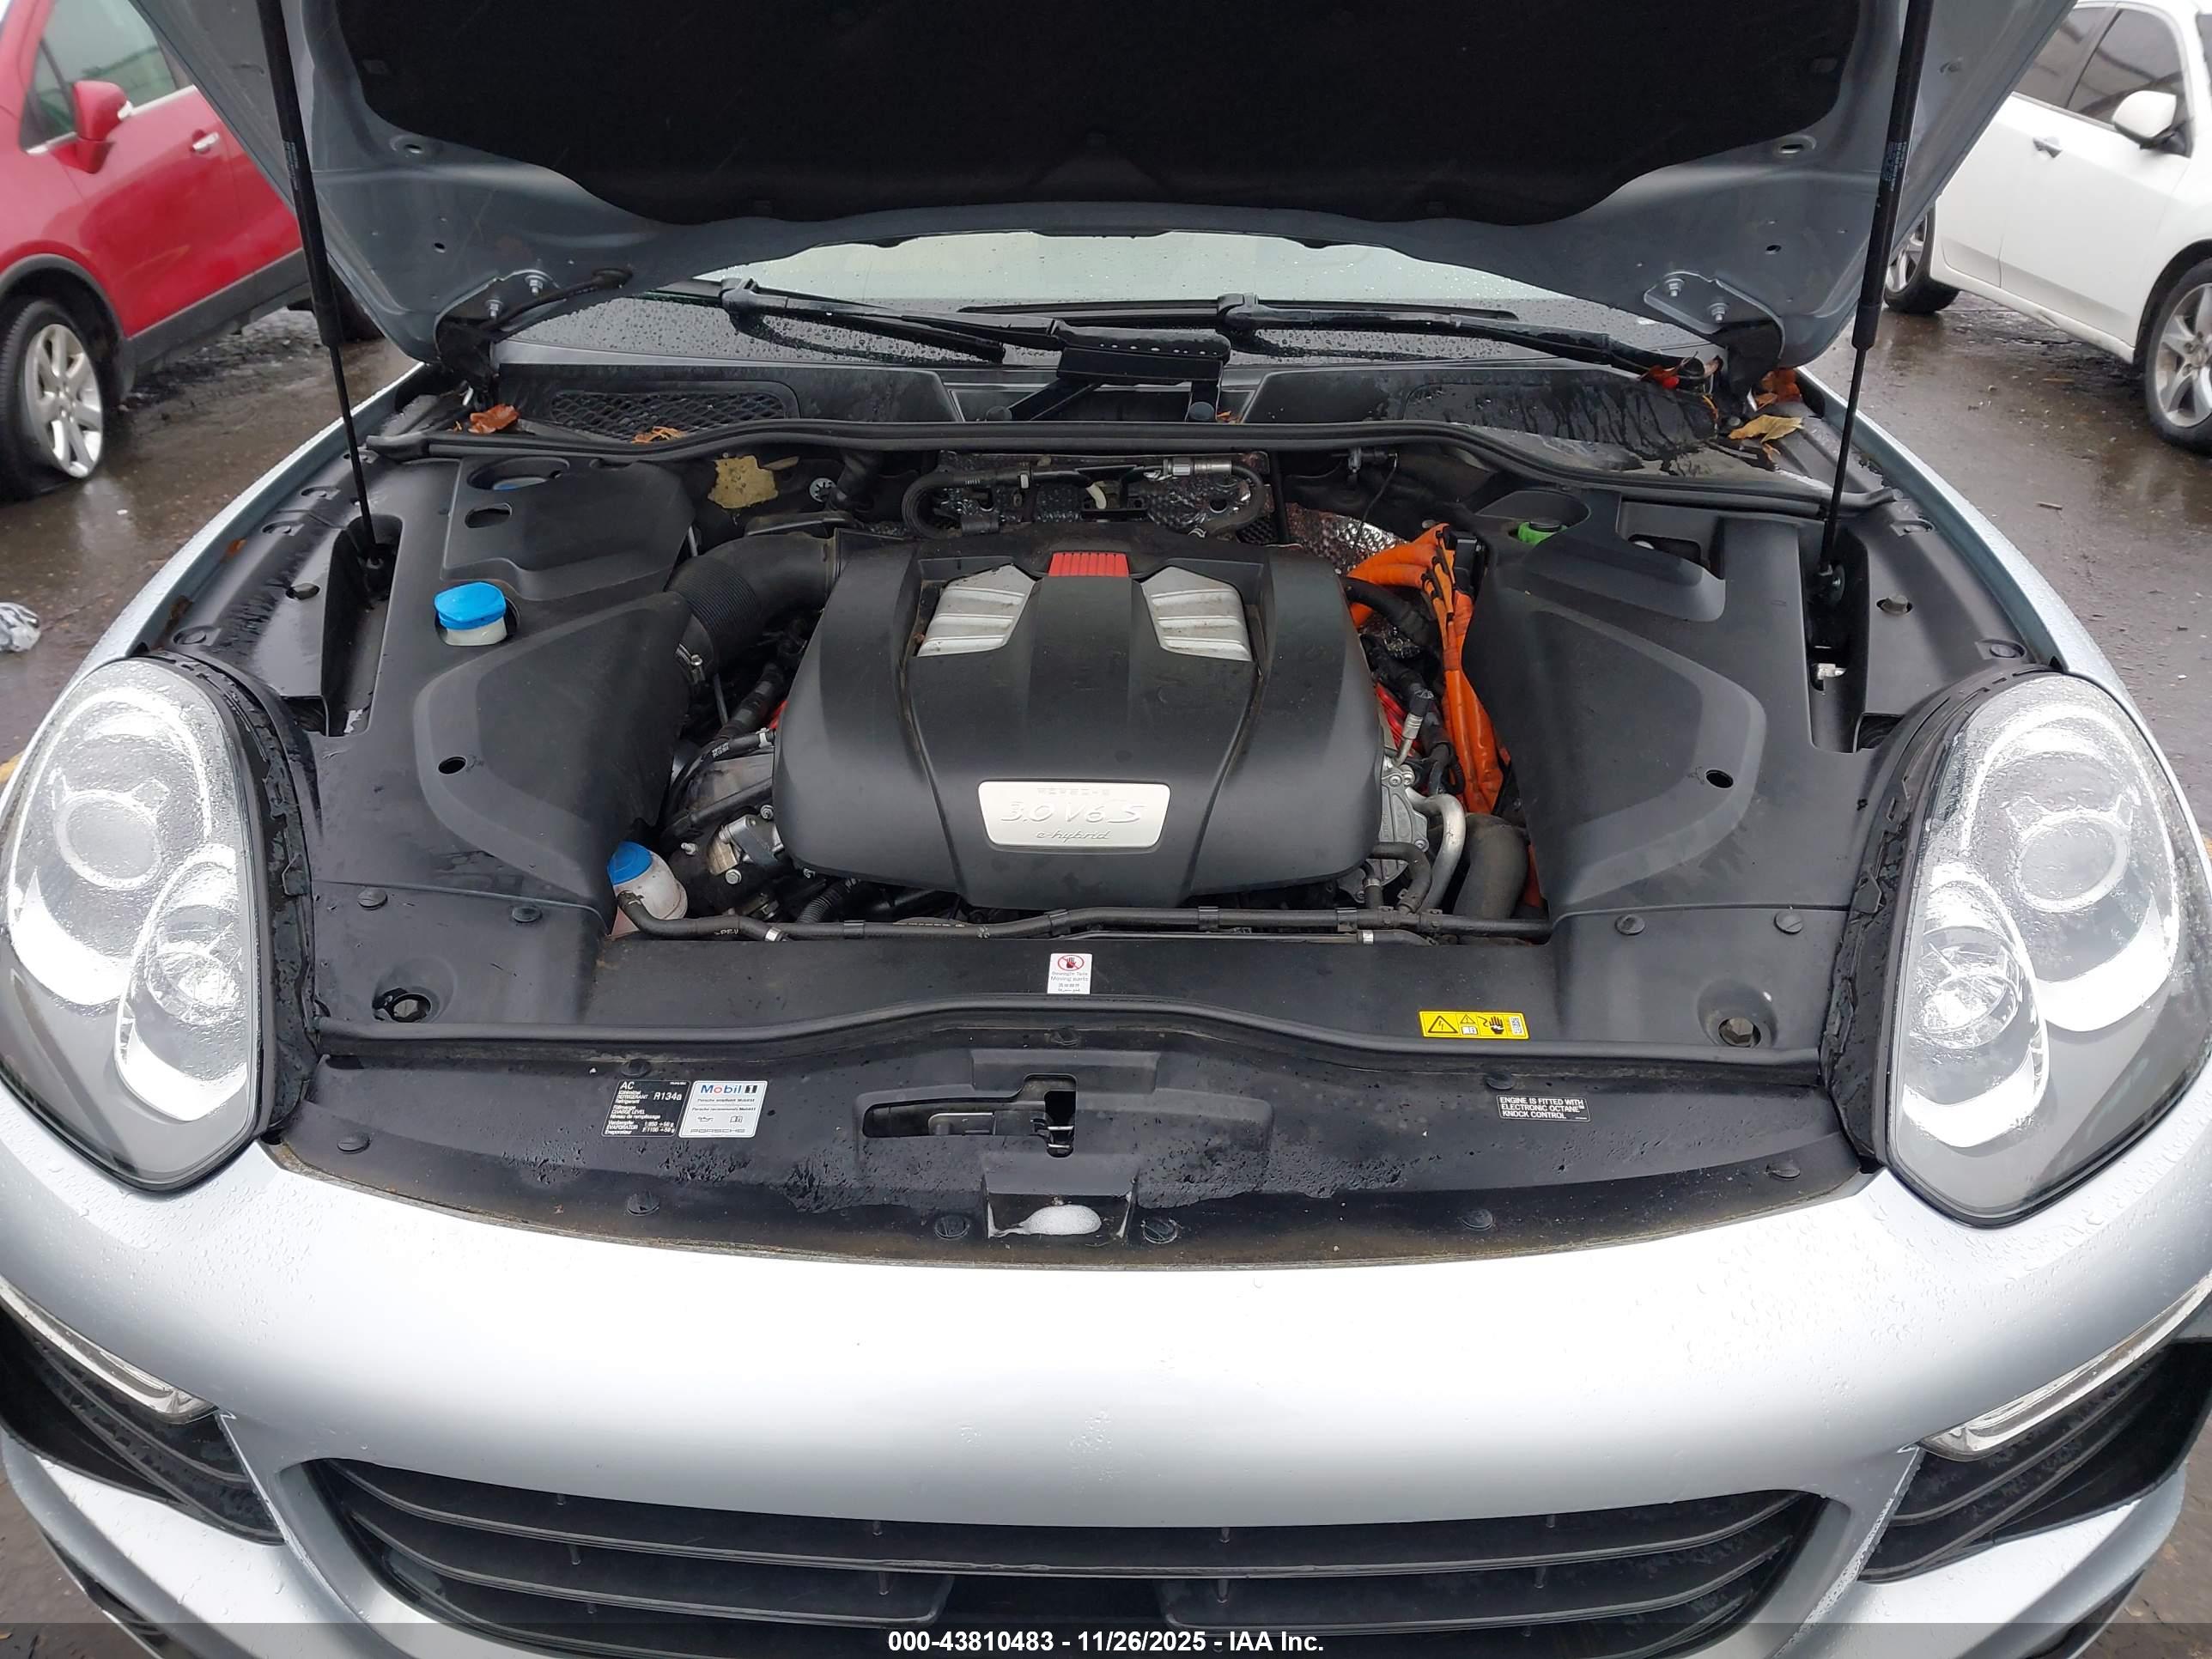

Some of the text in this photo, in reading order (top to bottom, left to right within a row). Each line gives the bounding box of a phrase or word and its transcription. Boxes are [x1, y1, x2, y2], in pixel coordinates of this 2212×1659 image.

[1000, 800, 1054, 823] 3.0
[1065, 802, 1105, 823] V6
[1036, 830, 1111, 843] e-hybrid
[700, 1085, 742, 1094] Mobil
[653, 1092, 683, 1101] R134a
